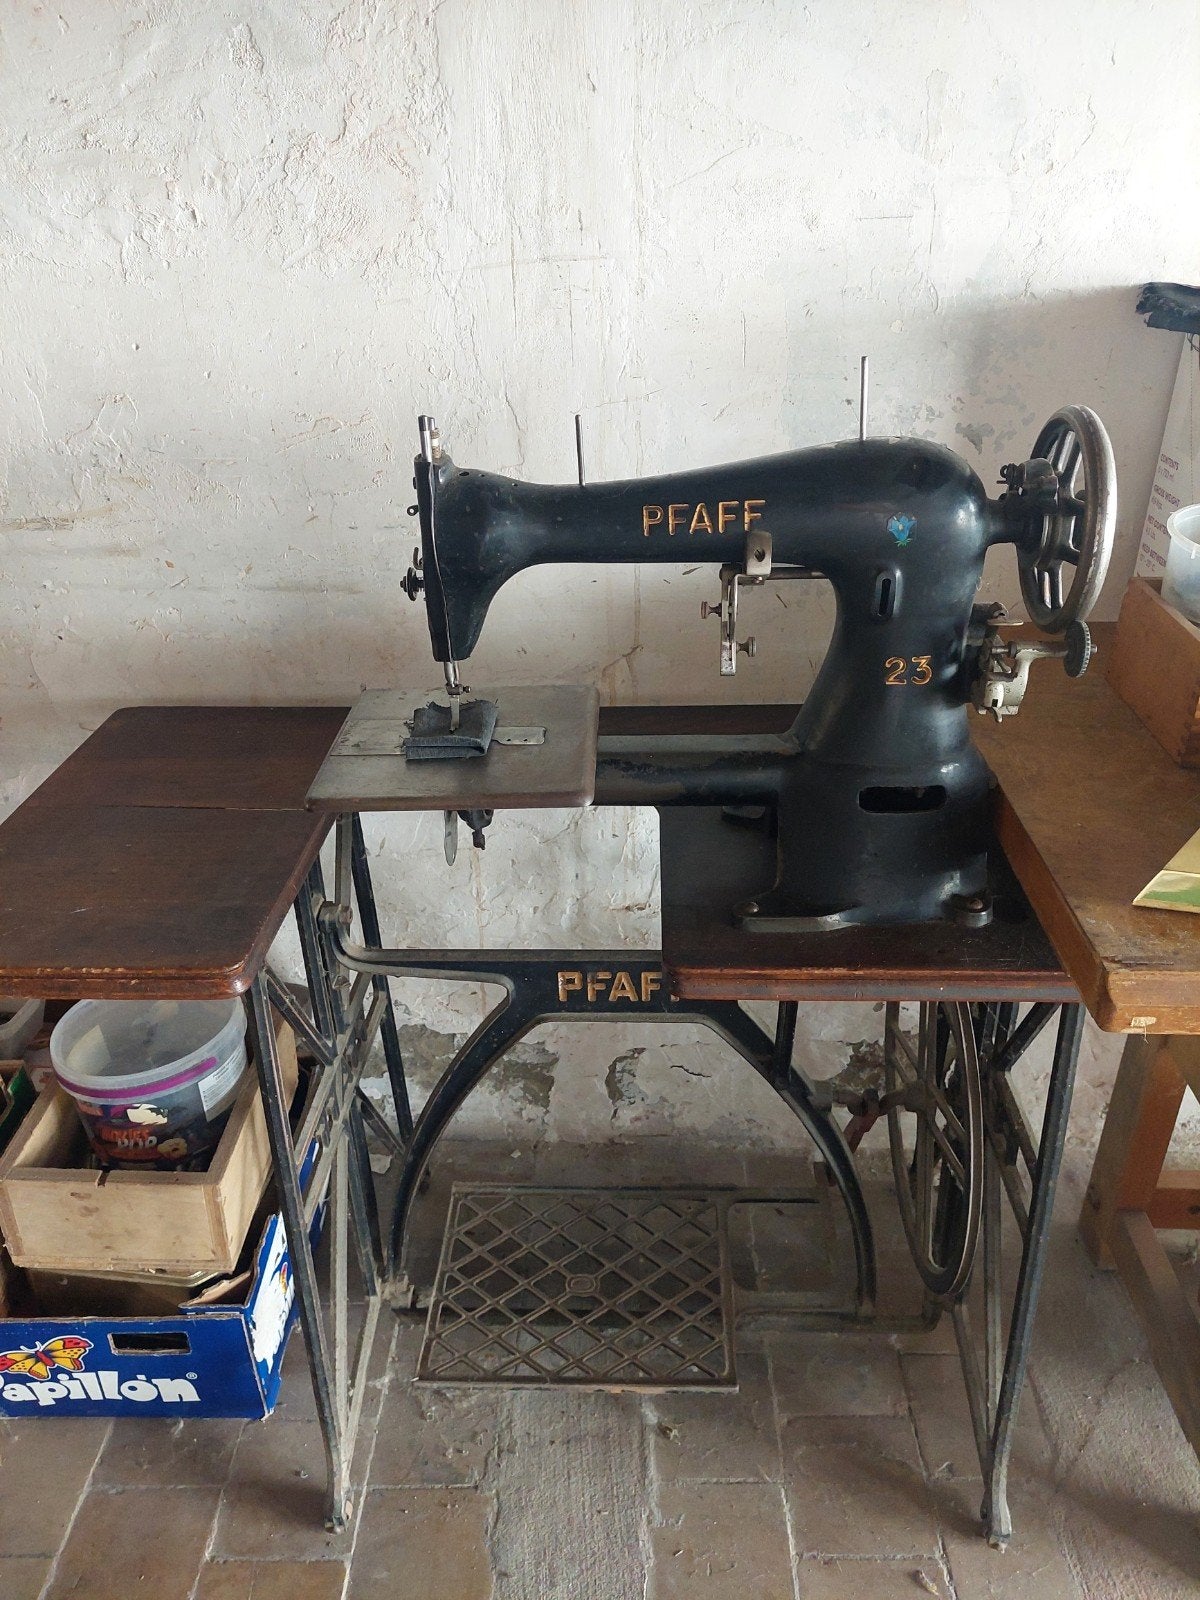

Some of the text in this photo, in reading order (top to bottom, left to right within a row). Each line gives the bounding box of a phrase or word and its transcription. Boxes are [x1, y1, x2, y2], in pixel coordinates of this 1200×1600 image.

[642, 499, 766, 537] PFAFF
[885, 655, 933, 685] 23
[557, 971, 680, 1002] PFAF
